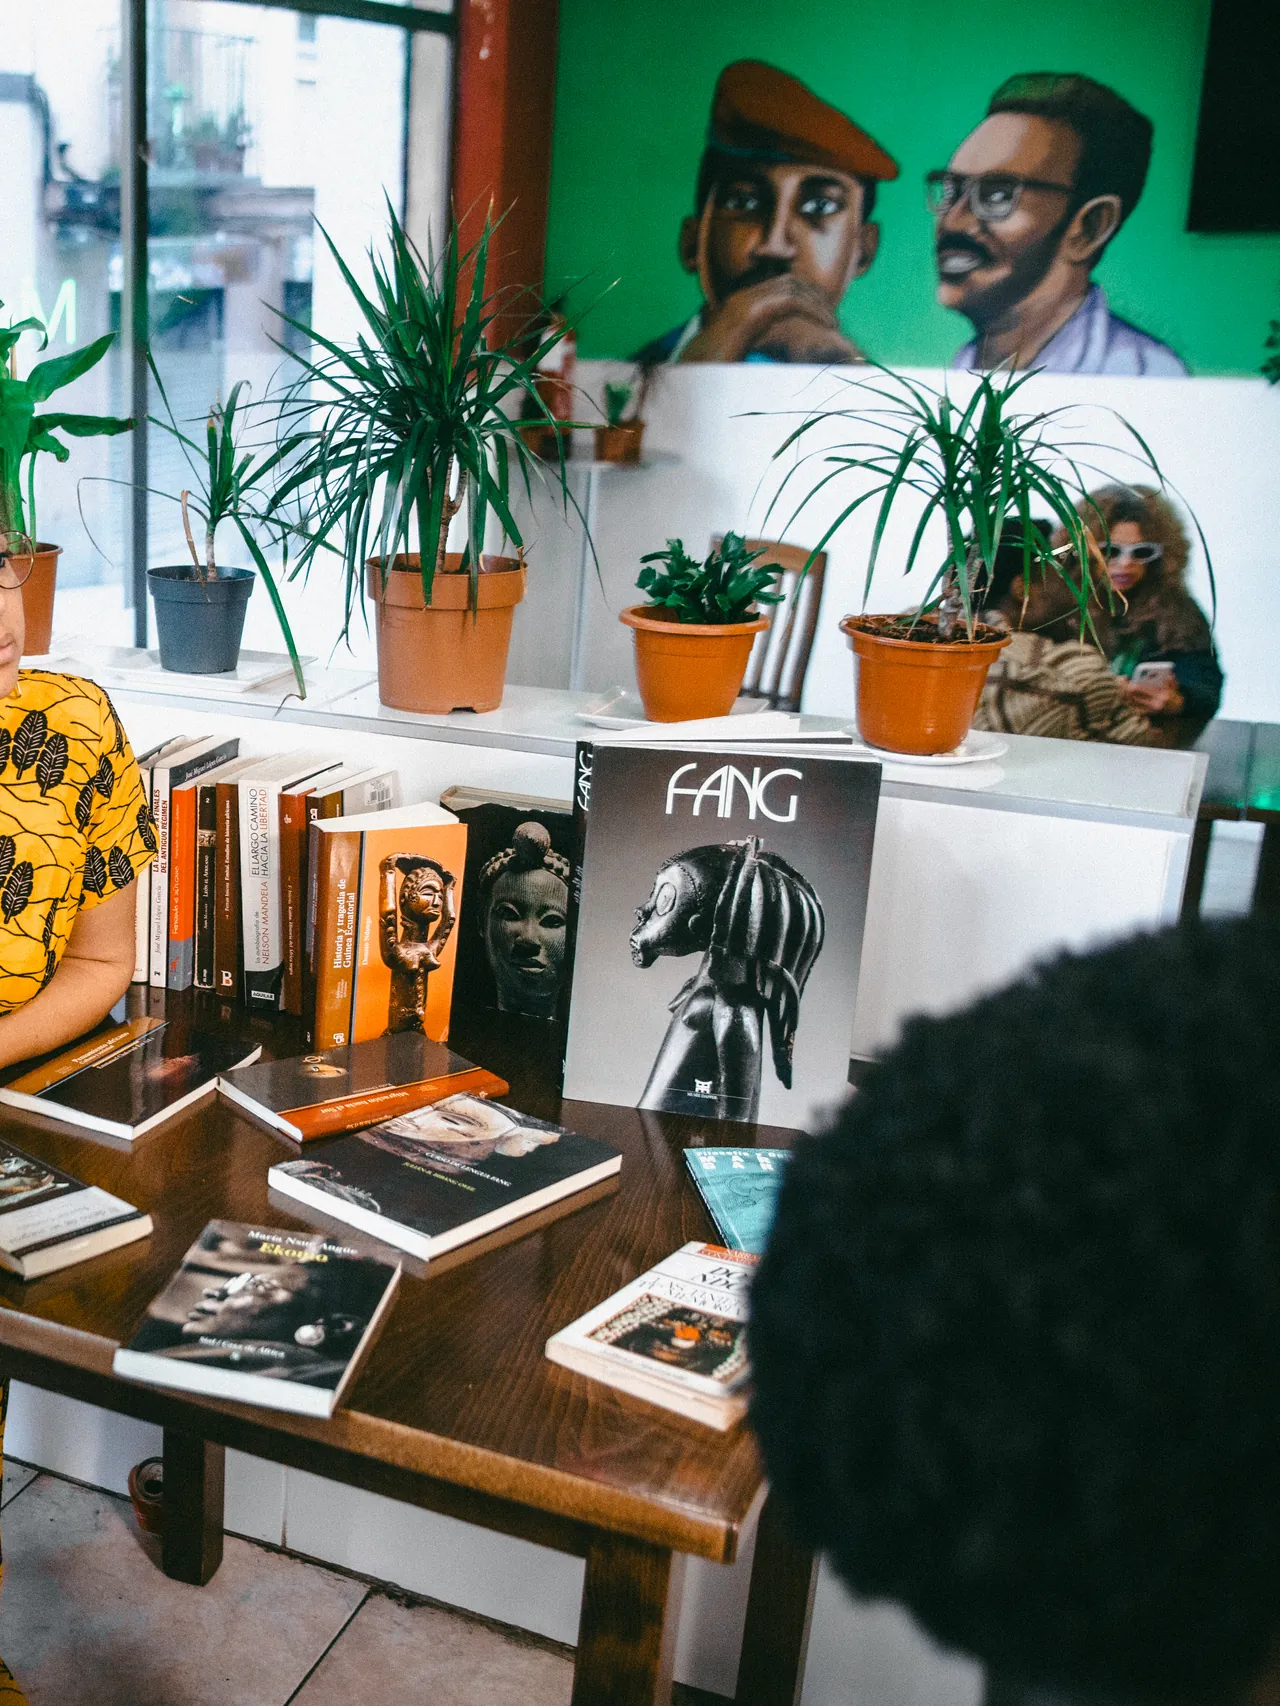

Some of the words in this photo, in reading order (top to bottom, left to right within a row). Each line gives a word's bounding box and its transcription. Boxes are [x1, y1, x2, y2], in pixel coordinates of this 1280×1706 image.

[665, 762, 803, 822] FANG
[160, 800, 168, 830] RÉGIMEN
[249, 788, 259, 830] CAMINO
[259, 789, 268, 830] LIBERTAD
[250, 832, 260, 865] LARGO
[260, 832, 268, 844] LA
[251, 867, 260, 876] EL
[260, 846, 269, 877] HACIA
[337, 879, 346, 890] de
[253, 911, 260, 919] de
[260, 881, 269, 925] MANDELA
[336, 891, 346, 926] tragedia
[345, 892, 355, 936] Ecuatorial
[261, 927, 270, 965] NELSON
[333, 935, 343, 969] Historia
[343, 937, 353, 968] Guinea
[221, 970, 233, 987] B
[247, 1230, 282, 1243] María
